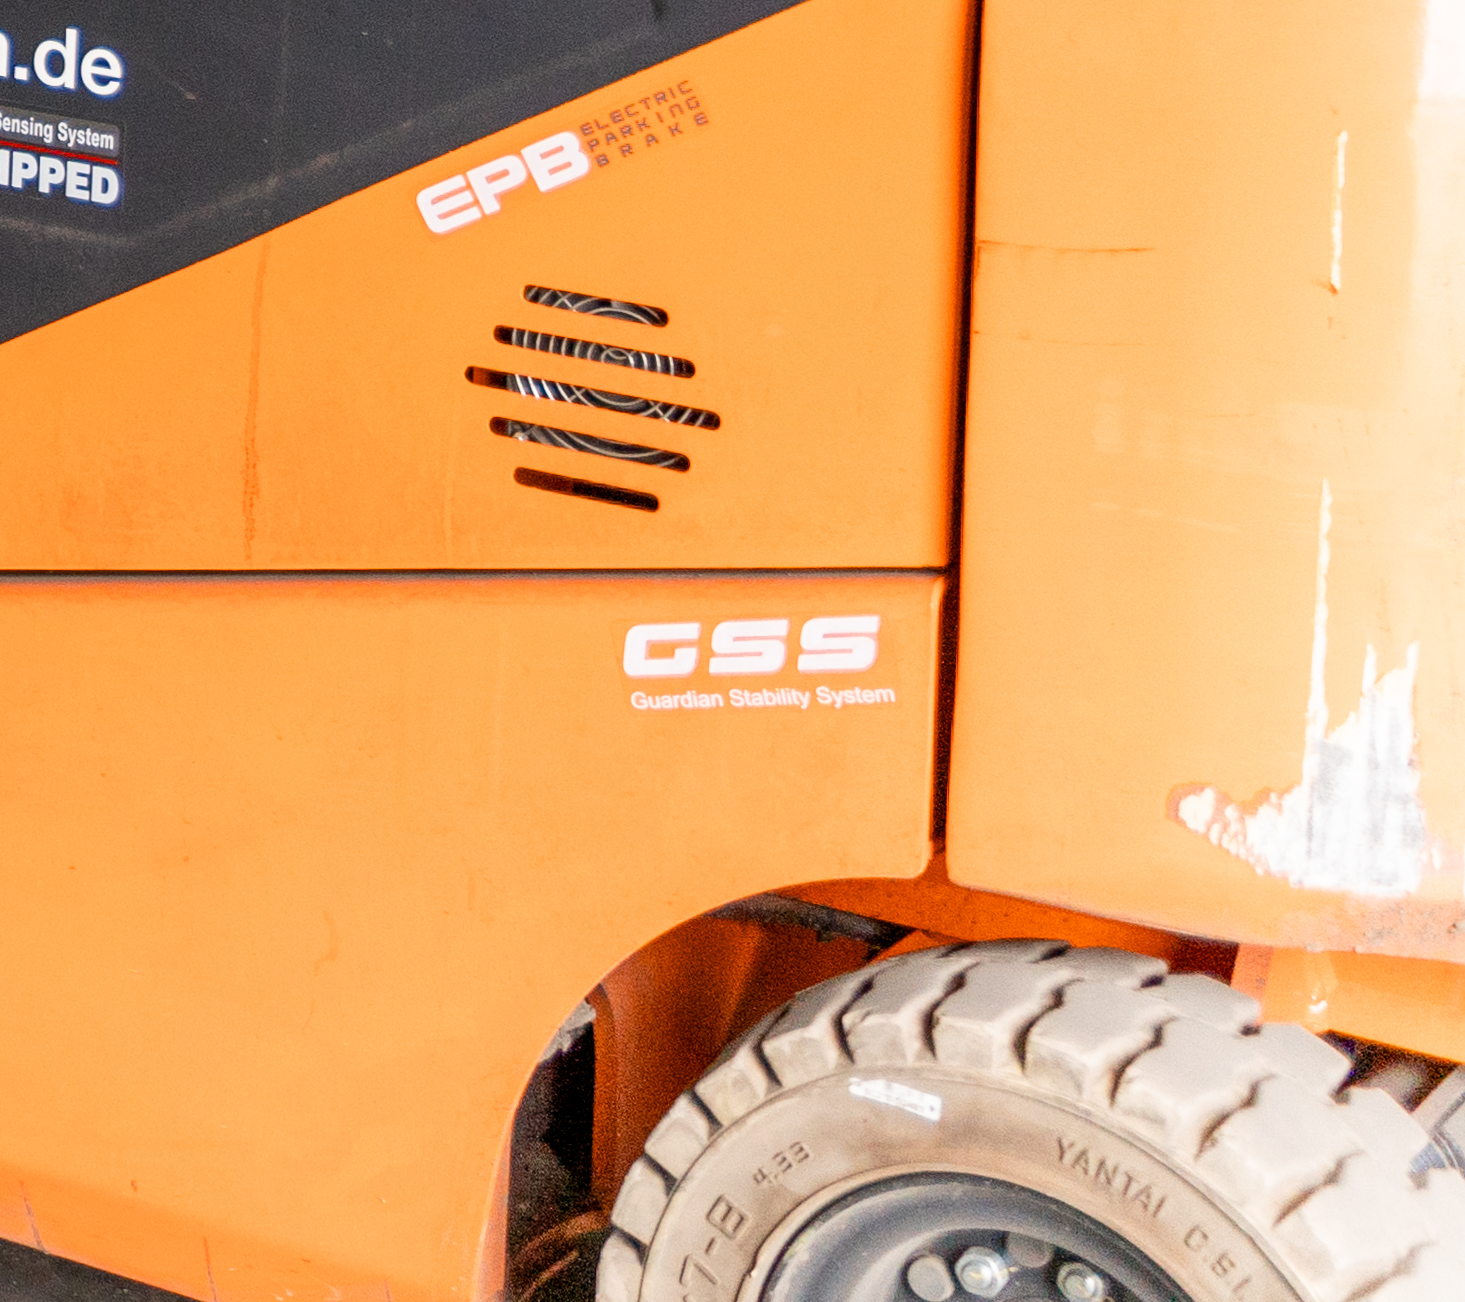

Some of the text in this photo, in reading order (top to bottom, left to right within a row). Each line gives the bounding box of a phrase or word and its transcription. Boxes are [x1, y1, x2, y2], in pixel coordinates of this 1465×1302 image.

[57, 122, 114, 150] System
[579, 80, 693, 137] ELECTRIC
[586, 96, 700, 152] PARKING
[595, 111, 709, 168] BRAKE
[416, 131, 592, 235] EPB
[622, 615, 881, 678] GSS
[630, 685, 896, 711] Guardian Stability System
[752, 1139, 811, 1185] 4.33
[1056, 1136, 1167, 1218] YANTAI
